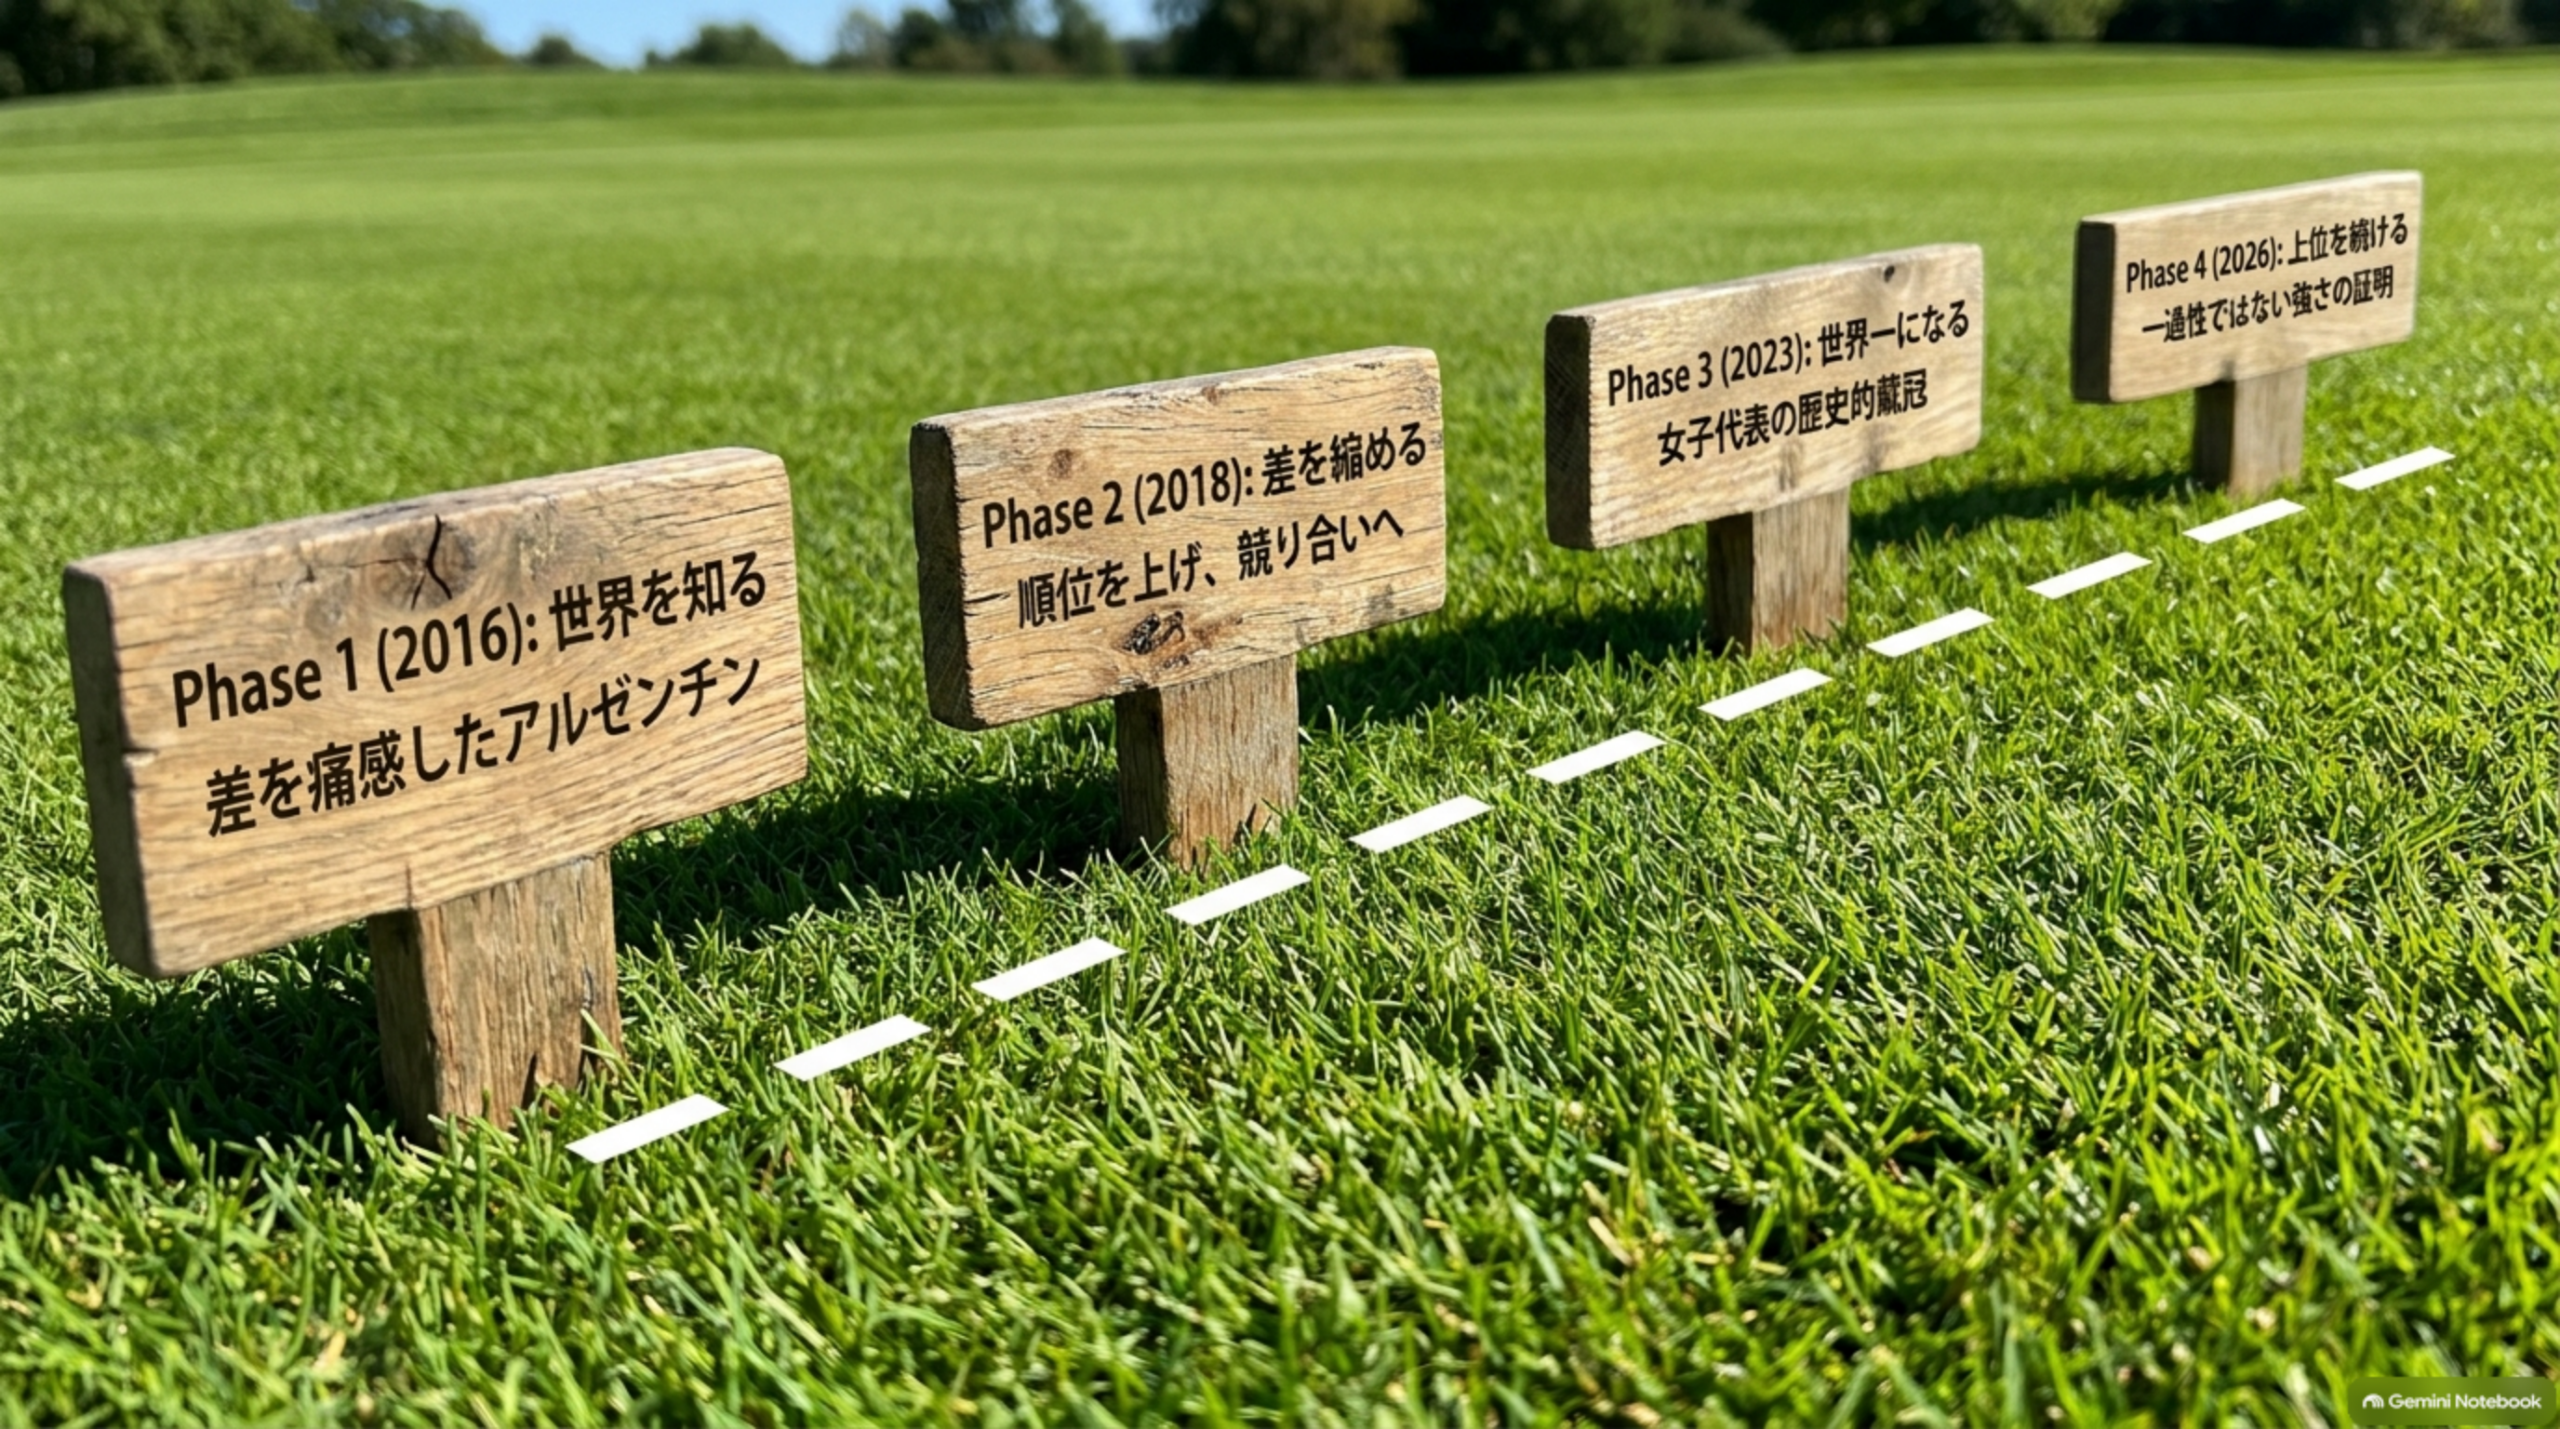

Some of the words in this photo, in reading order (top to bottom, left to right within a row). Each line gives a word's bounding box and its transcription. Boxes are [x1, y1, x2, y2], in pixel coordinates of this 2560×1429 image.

[2126, 258, 2189, 293] Phase
[2193, 249, 2208, 280] 4
[2212, 236, 2283, 281] (2026):
[1608, 364, 1690, 406] Phase
[1697, 351, 1713, 390] 3
[1720, 332, 1811, 389] (2023):
[1817, 299, 1971, 368] 世界一になる
[983, 497, 1093, 548] Phase
[1103, 481, 1124, 525] 2
[1134, 457, 1254, 525] (2018):
[1261, 421, 1427, 497] 差を縮める
[1018, 508, 1405, 630] 順位を上げ、競り合いへ
[172, 656, 323, 729] Phase
[335, 637, 359, 692] 1
[377, 602, 540, 694] (2016):
[547, 550, 767, 653] 世界を知る
[206, 656, 763, 838] 差を痛感したアルゼンチン
